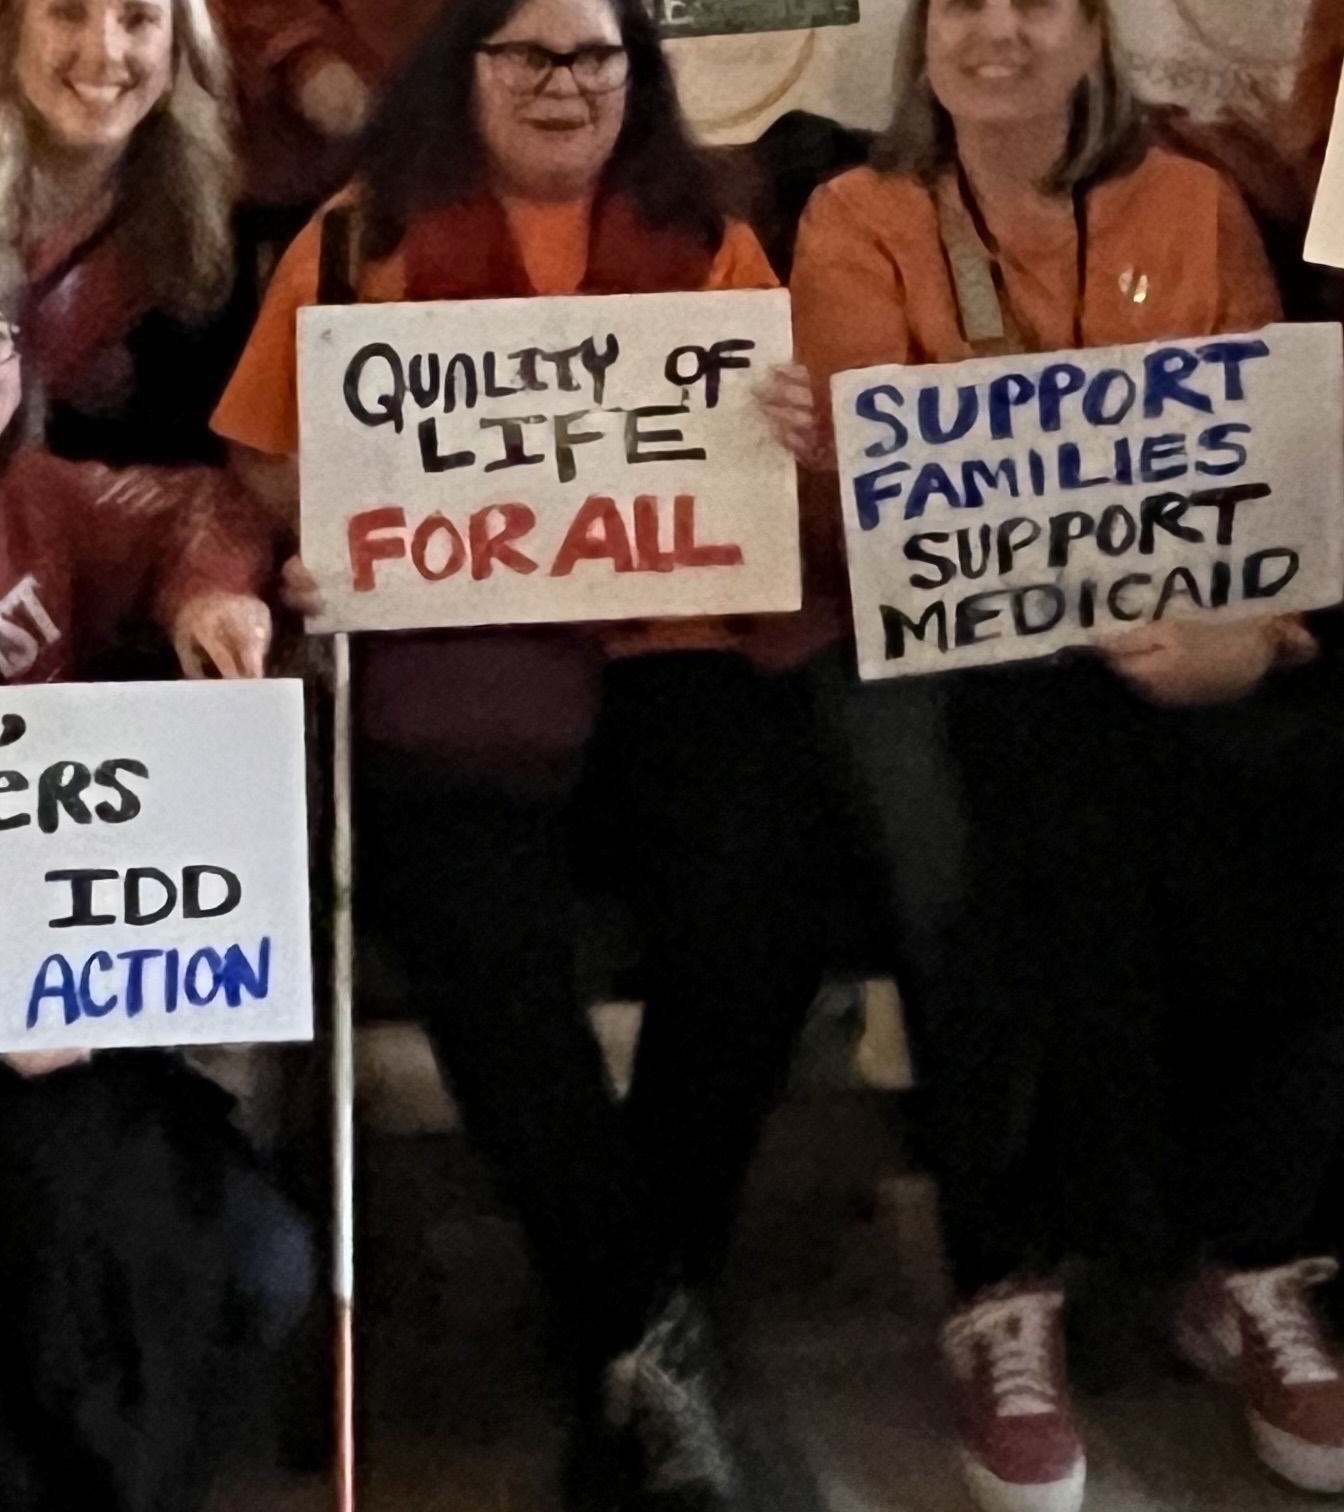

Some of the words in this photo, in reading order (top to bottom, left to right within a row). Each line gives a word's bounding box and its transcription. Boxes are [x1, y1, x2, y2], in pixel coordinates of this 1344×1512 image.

[664, 339, 756, 409] OF
[855, 339, 1270, 458] SUPPORT
[418, 405, 707, 483] LIFE
[853, 422, 1252, 531] FAMILIES
[347, 501, 539, 592] FOR
[549, 494, 744, 577] ALL
[903, 482, 1272, 589] SUPPORT
[879, 547, 1300, 660] MEDICAID
[44, 864, 242, 928] IDD
[26, 936, 271, 1029] ACTION
